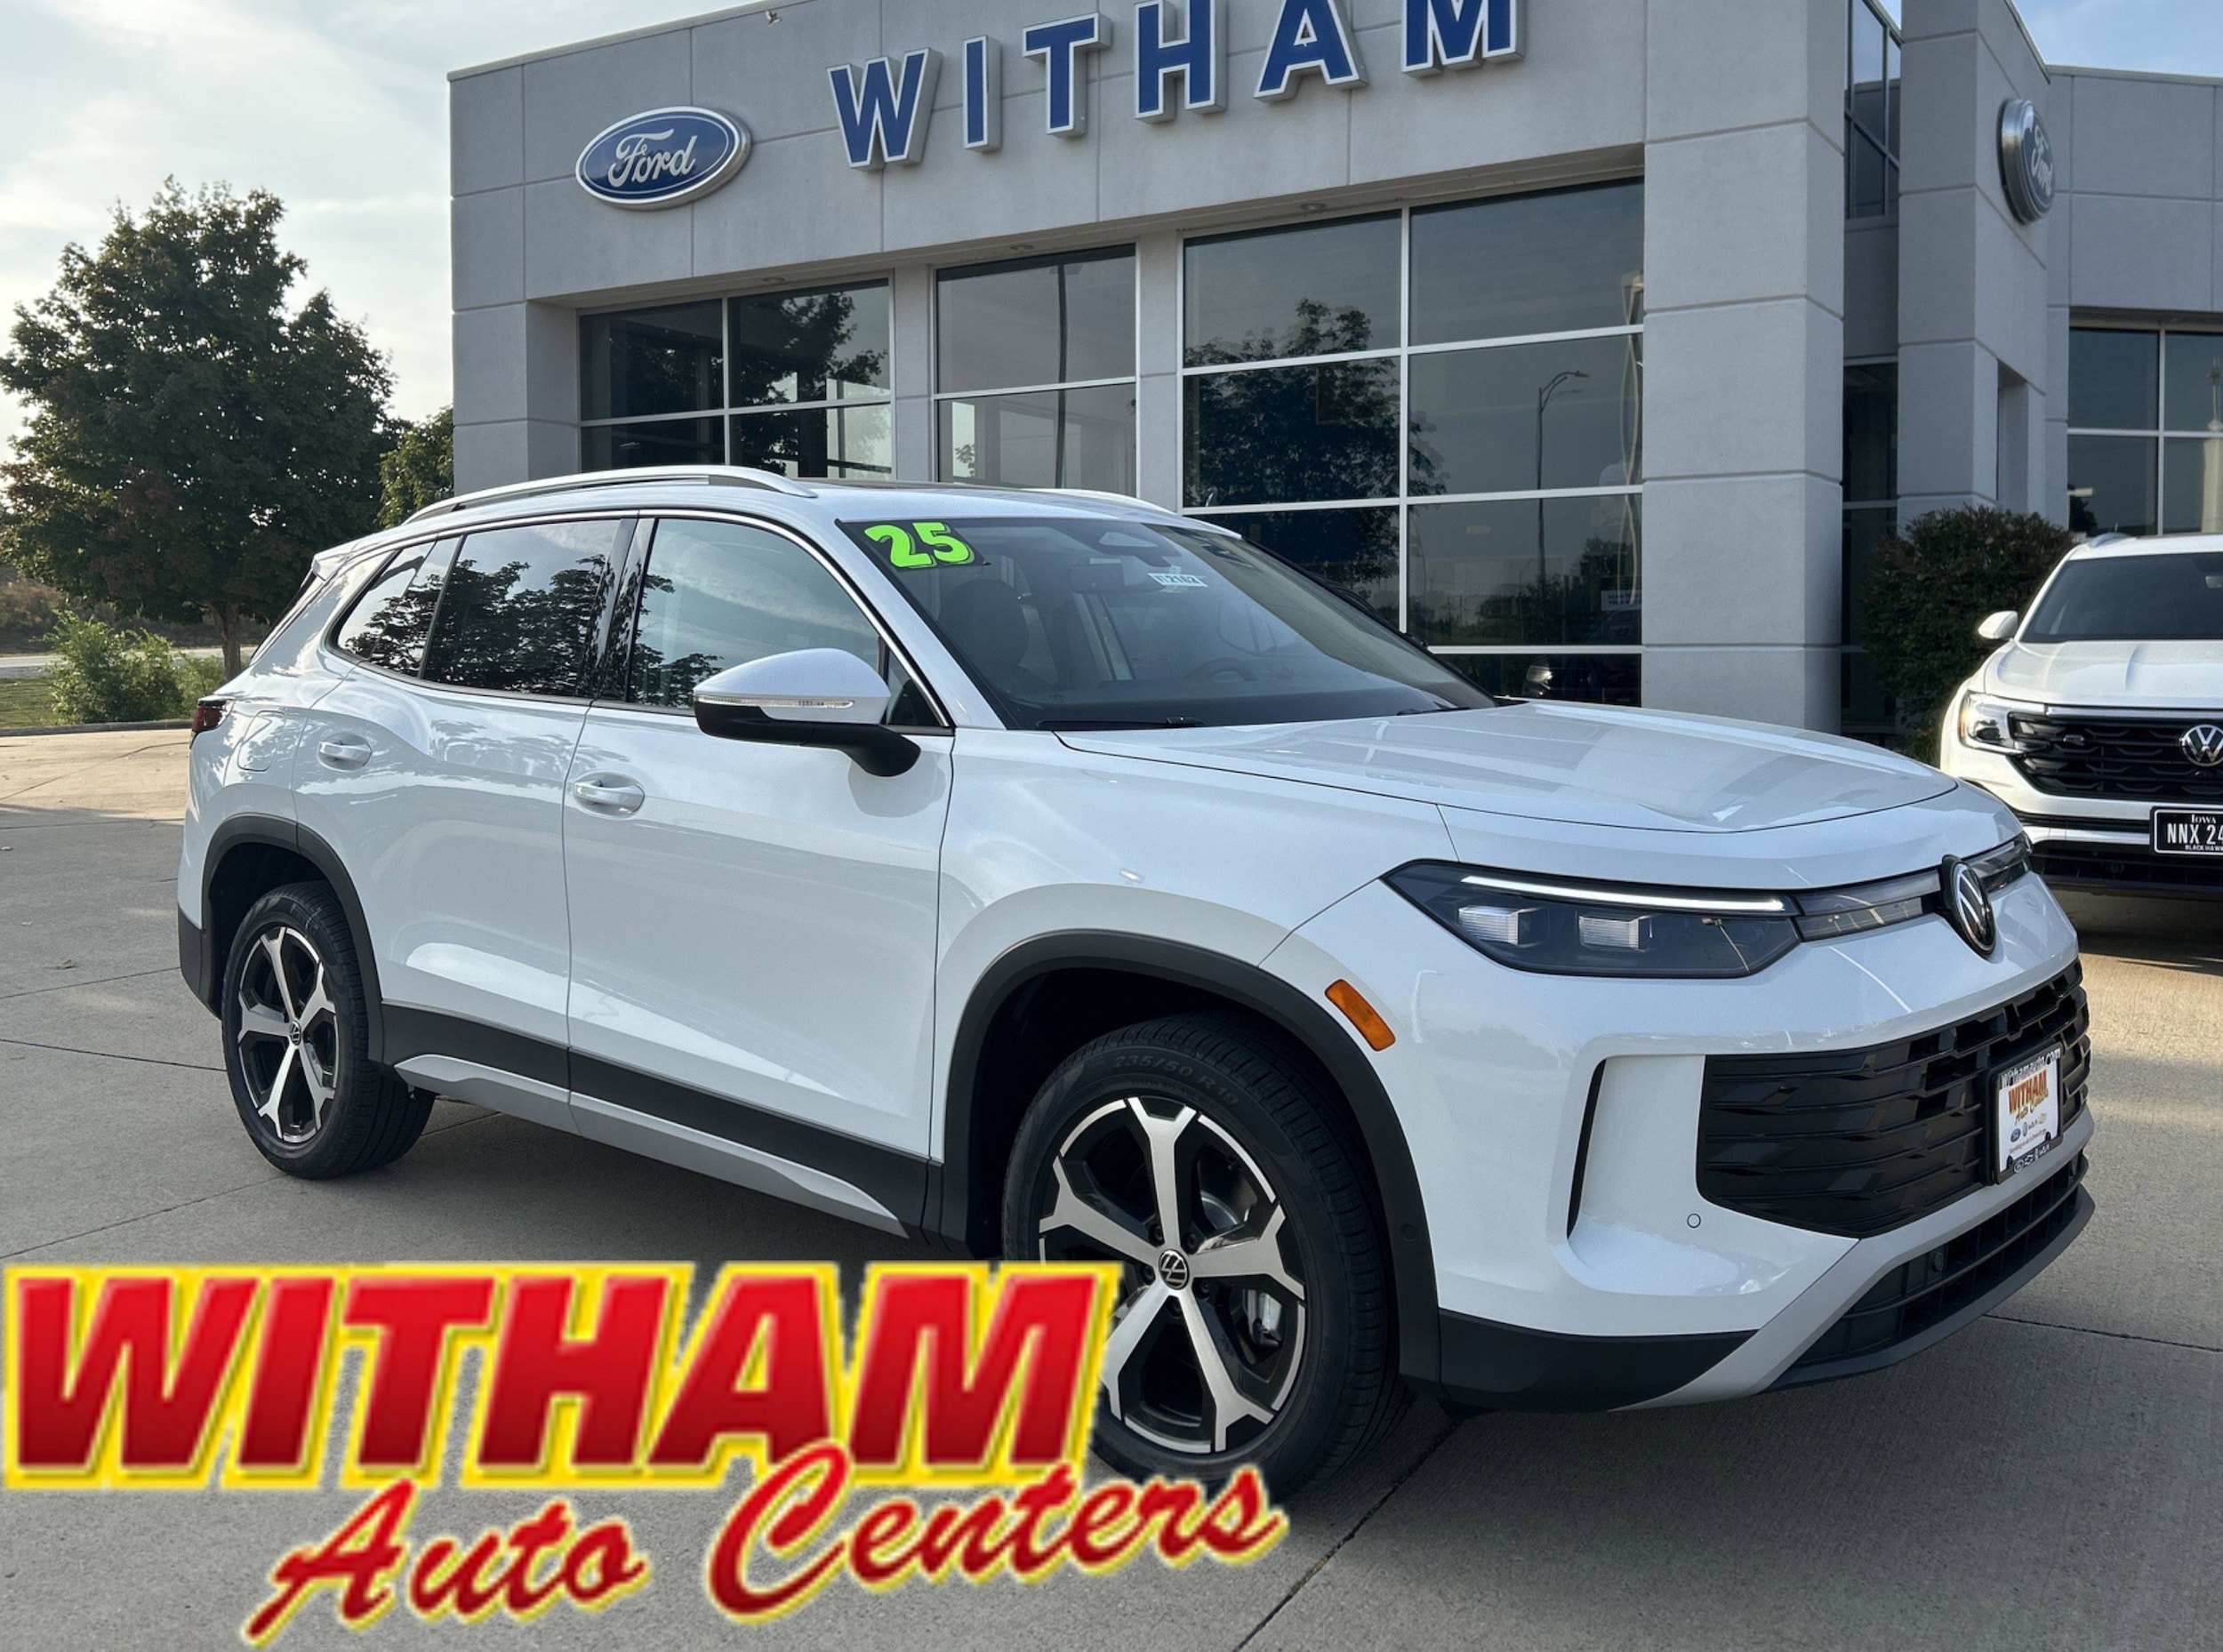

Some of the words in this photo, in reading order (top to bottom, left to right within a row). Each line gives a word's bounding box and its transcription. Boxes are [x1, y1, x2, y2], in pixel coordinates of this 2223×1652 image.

[826, 0, 1522, 171] WITHAM
[607, 128, 700, 188] Ford
[863, 521, 975, 569] 25
[2167, 822, 2200, 845] NNX
